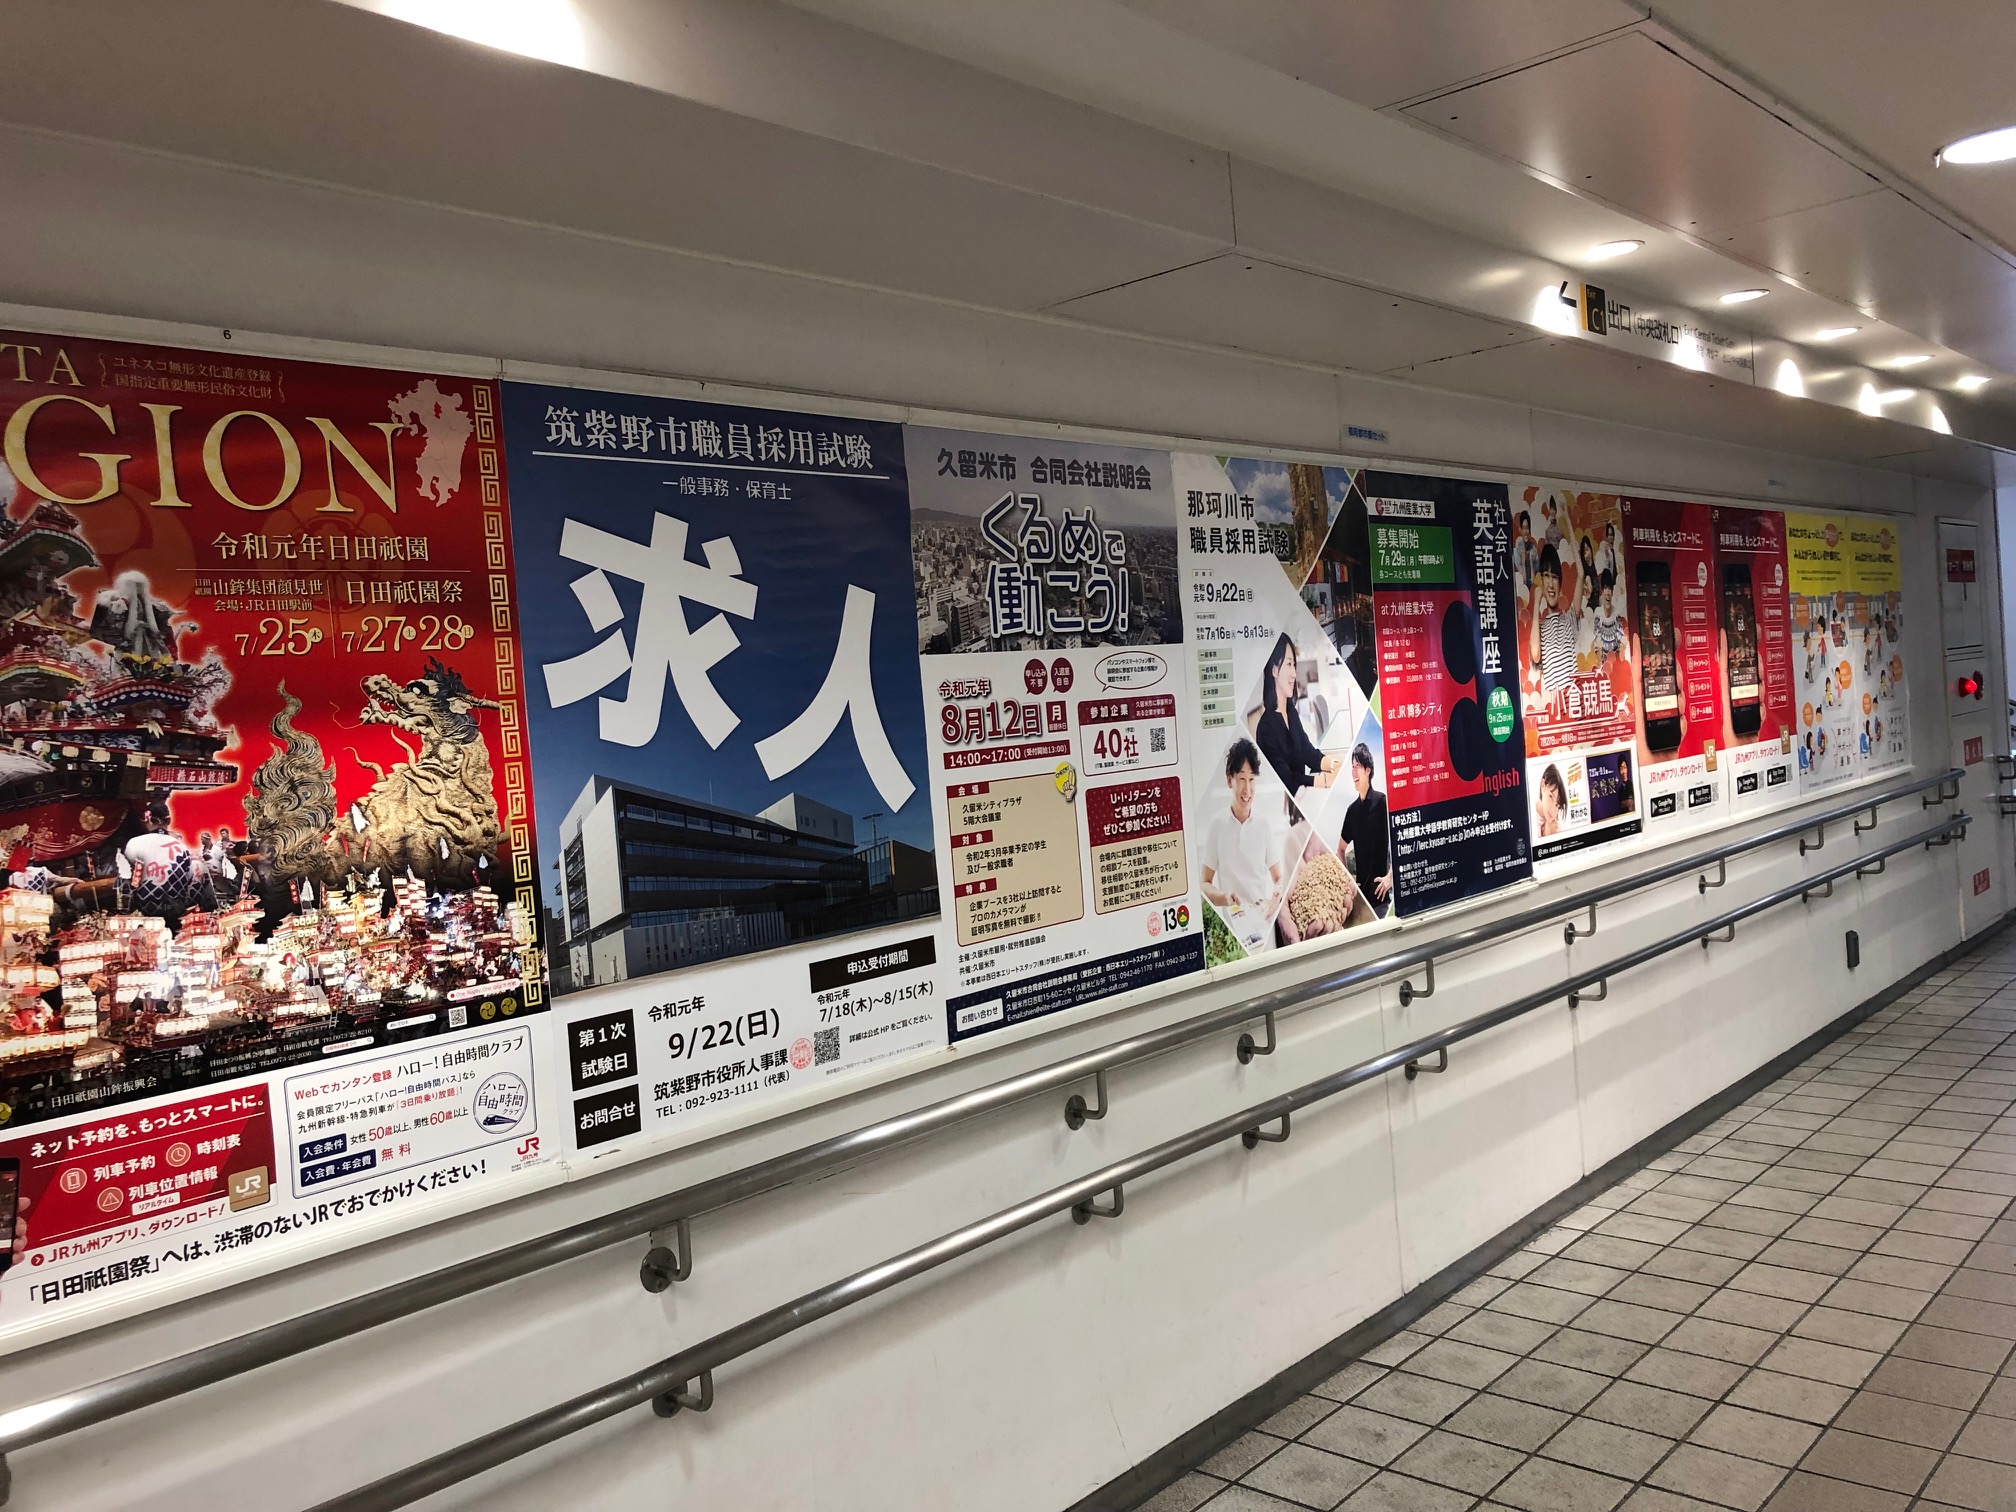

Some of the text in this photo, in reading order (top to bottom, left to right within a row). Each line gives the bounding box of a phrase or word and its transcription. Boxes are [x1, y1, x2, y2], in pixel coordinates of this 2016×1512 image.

[1592, 307, 1606, 332] C1
[223, 330, 232, 340] 6
[113, 356, 272, 382] ユネスコ無形文化遺産登録
[115, 373, 272, 399] 国指定重要無形民俗文化財
[543, 404, 874, 470] 筑紫野市職員採用試験
[3, 395, 404, 514] GION
[937, 447, 1152, 491] 久留米市 合同会社説明会
[662, 476, 792, 501] 一般事務・保育士
[1187, 490, 1255, 521] 那珂川市
[1393, 501, 1432, 516] 九州産業大学
[980, 491, 1126, 565] くるめで
[1189, 526, 1290, 555] 職員採用試験
[1377, 528, 1420, 549] 募集開始
[1493, 500, 1509, 581] 社会人
[211, 531, 429, 562] 令和元年日田祇園
[346, 579, 463, 605] 日田祇園祭
[985, 561, 1129, 638] 働こう!
[1472, 498, 1502, 675] 英語講座
[1391, 601, 1434, 615] 九州産業大学
[542, 510, 917, 814] 求人
[939, 677, 991, 698] 令和元年
[847, 948, 909, 976] 申込受付期間
[648, 996, 705, 1022] 令和元年
[816, 988, 851, 1006] 令和元年
[668, 1008, 781, 1060] 9/22(日)
[582, 1053, 628, 1079] 試験日
[653, 1048, 788, 1101] 筑紫野市役所人事課
[294, 1070, 392, 1101] Webでカンタン登録
[30, 1092, 264, 1158] ネット予約を、もっとスマートに。
[580, 1101, 636, 1130] お問合せ
[196, 1133, 242, 1155] 時刻表
[303, 1139, 343, 1158] 入会条件
[517, 1137, 540, 1155] JR
[93, 1155, 156, 1182] 列車予約
[304, 1156, 372, 1182] 入会費・年会費
[128, 1166, 219, 1201] 列車位置情報
[235, 1174, 262, 1195] JR
[48, 1203, 226, 1264] JR九州アプリ、ダウンロード!
